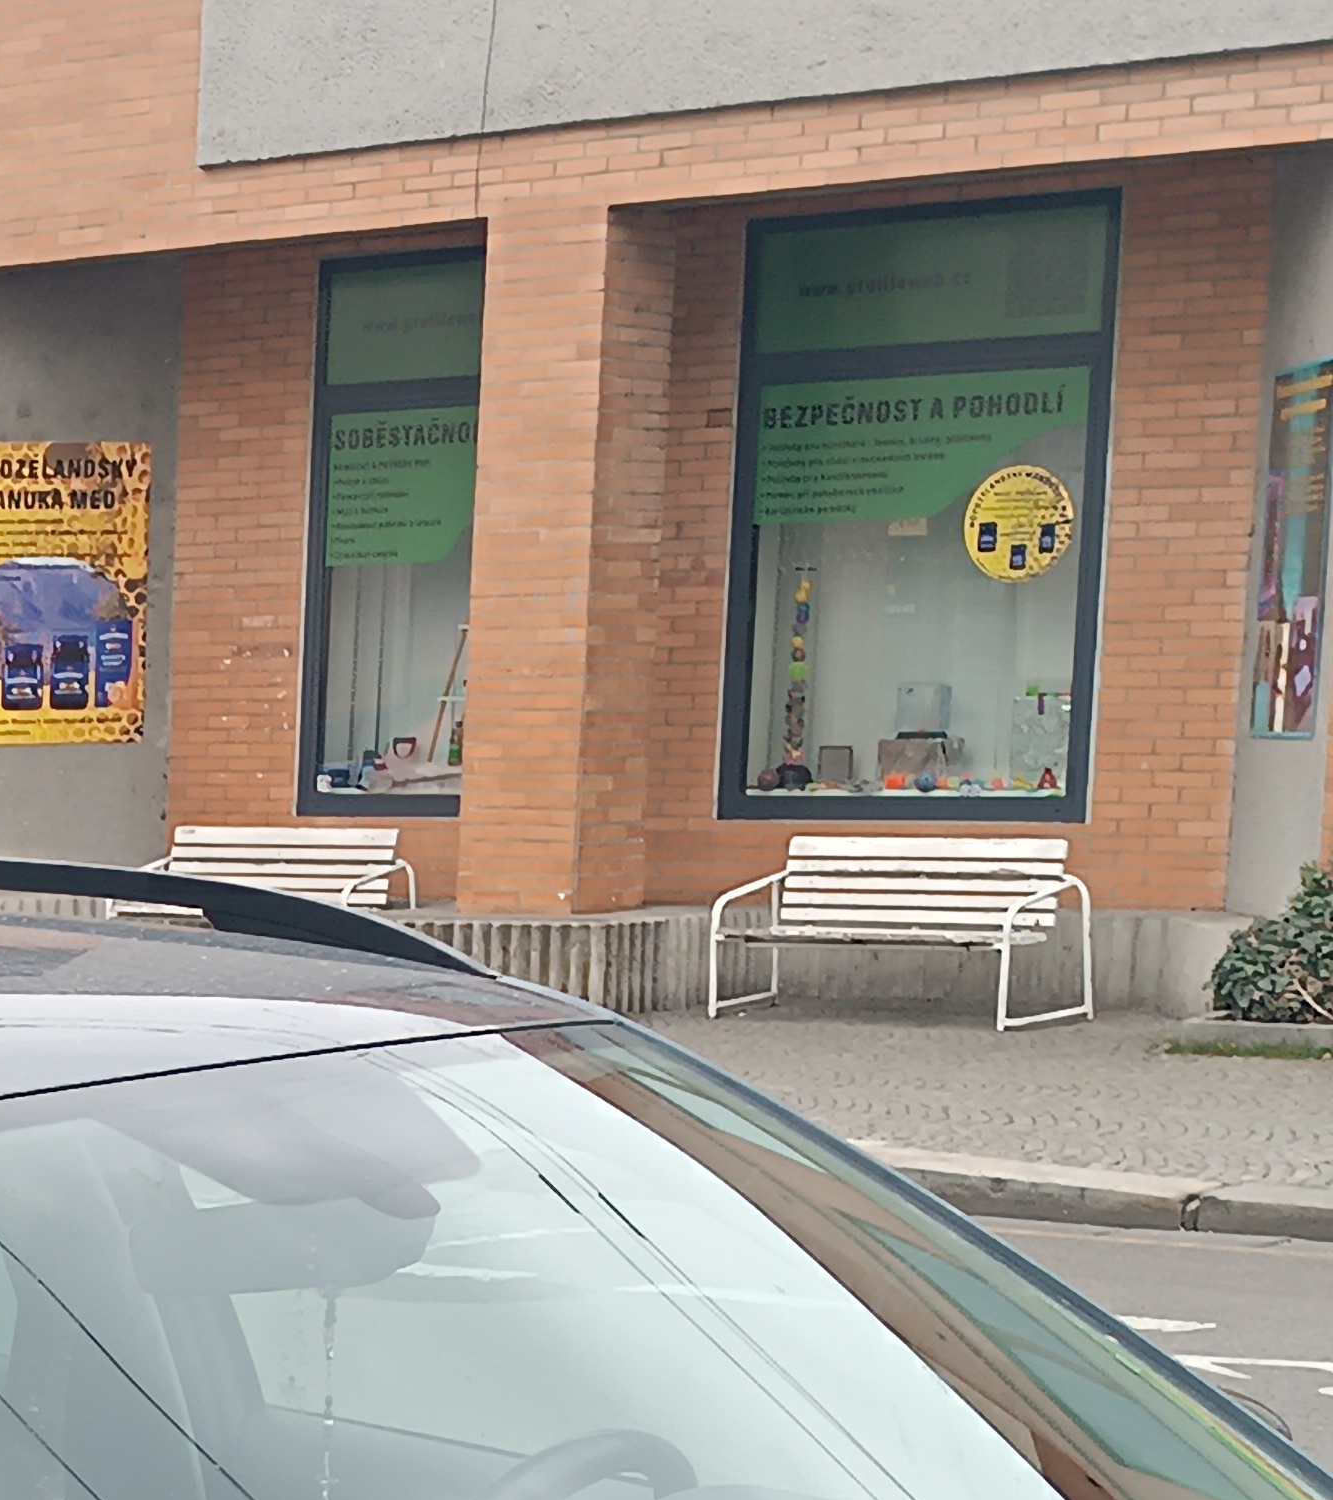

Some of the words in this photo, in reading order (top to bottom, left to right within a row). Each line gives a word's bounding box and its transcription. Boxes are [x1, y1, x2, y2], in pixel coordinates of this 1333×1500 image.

[763, 396, 923, 430] BEZPEČNOST
[929, 397, 945, 420] A
[953, 384, 1067, 419] POHODLÍ
[334, 418, 478, 451] SOBĚSTAČNO
[70, 489, 116, 510] MED
